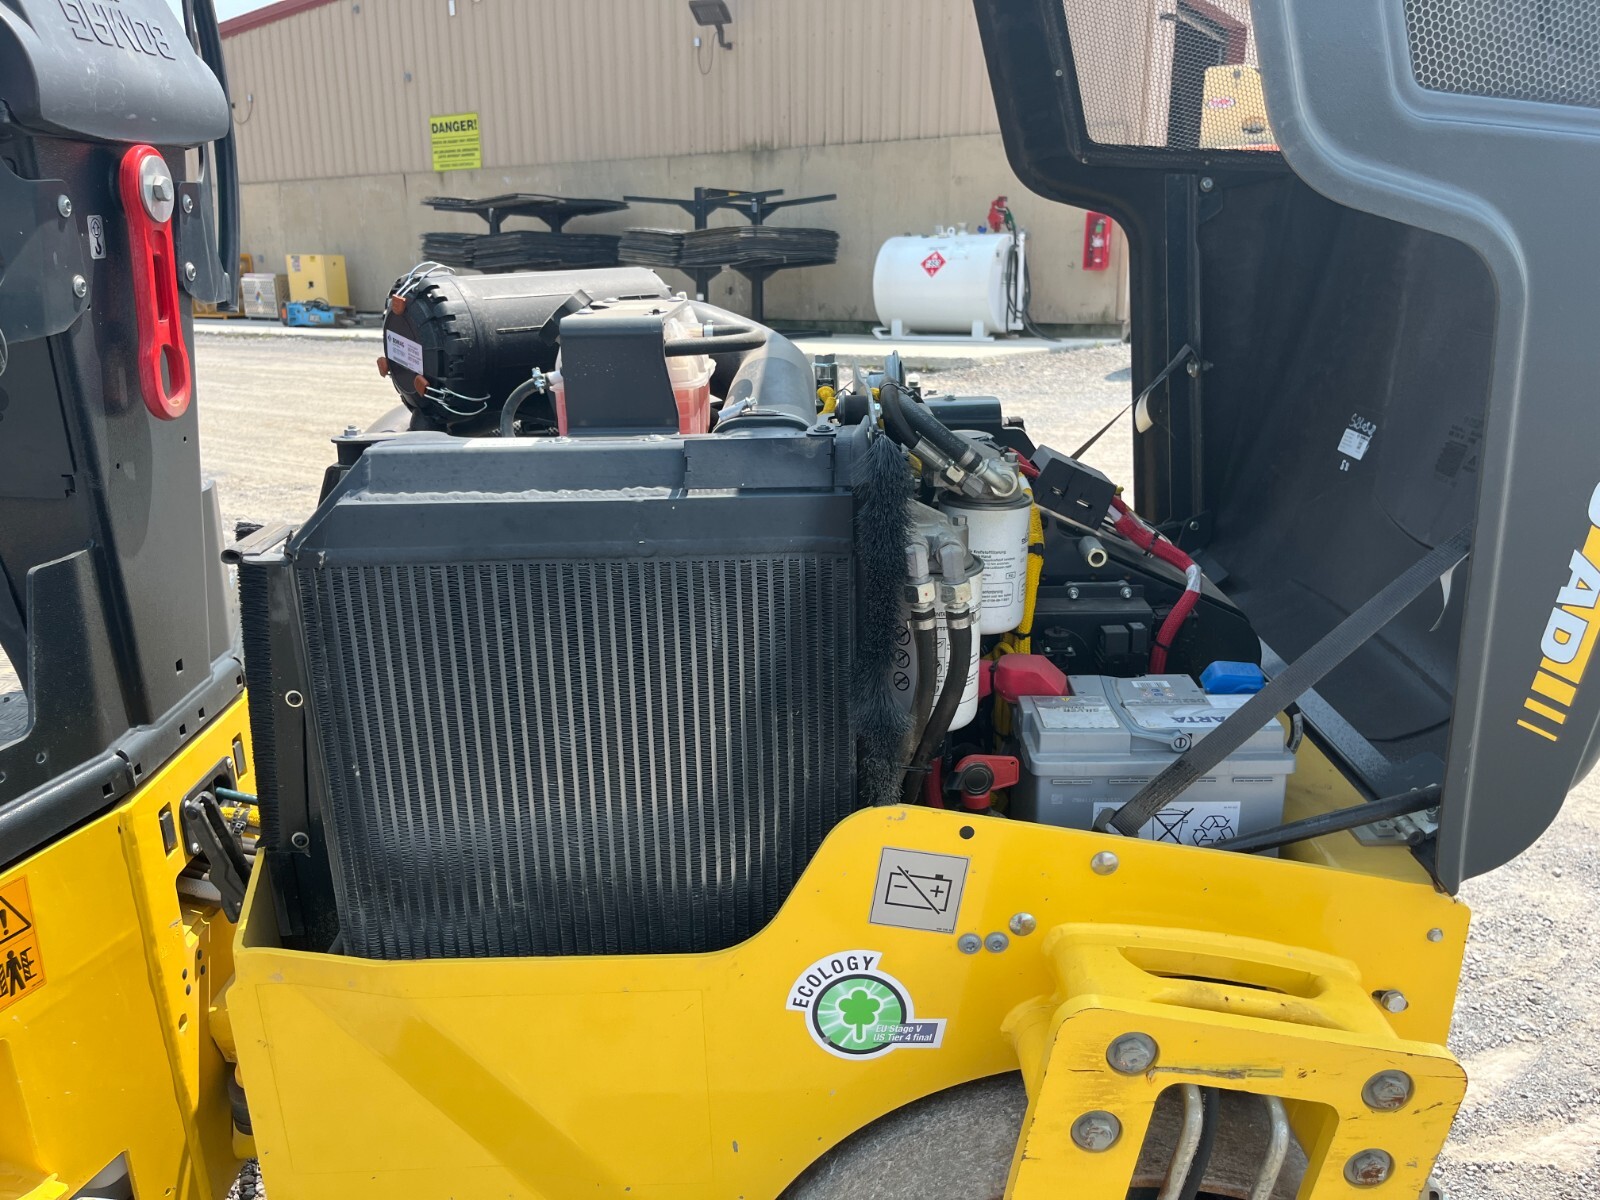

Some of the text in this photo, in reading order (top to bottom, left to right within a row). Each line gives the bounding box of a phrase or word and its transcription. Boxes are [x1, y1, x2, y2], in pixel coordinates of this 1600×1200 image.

[57, 0, 177, 61] BOMAG
[431, 119, 477, 134] DANGER!
[1170, 716, 1226, 724] ARTA
[792, 955, 874, 1009] ECOLOGY
[875, 1024, 923, 1034] EU Stage V
[873, 1033, 886, 1041] US
[887, 1033, 904, 1041] Tier
[912, 1033, 933, 1042] final
